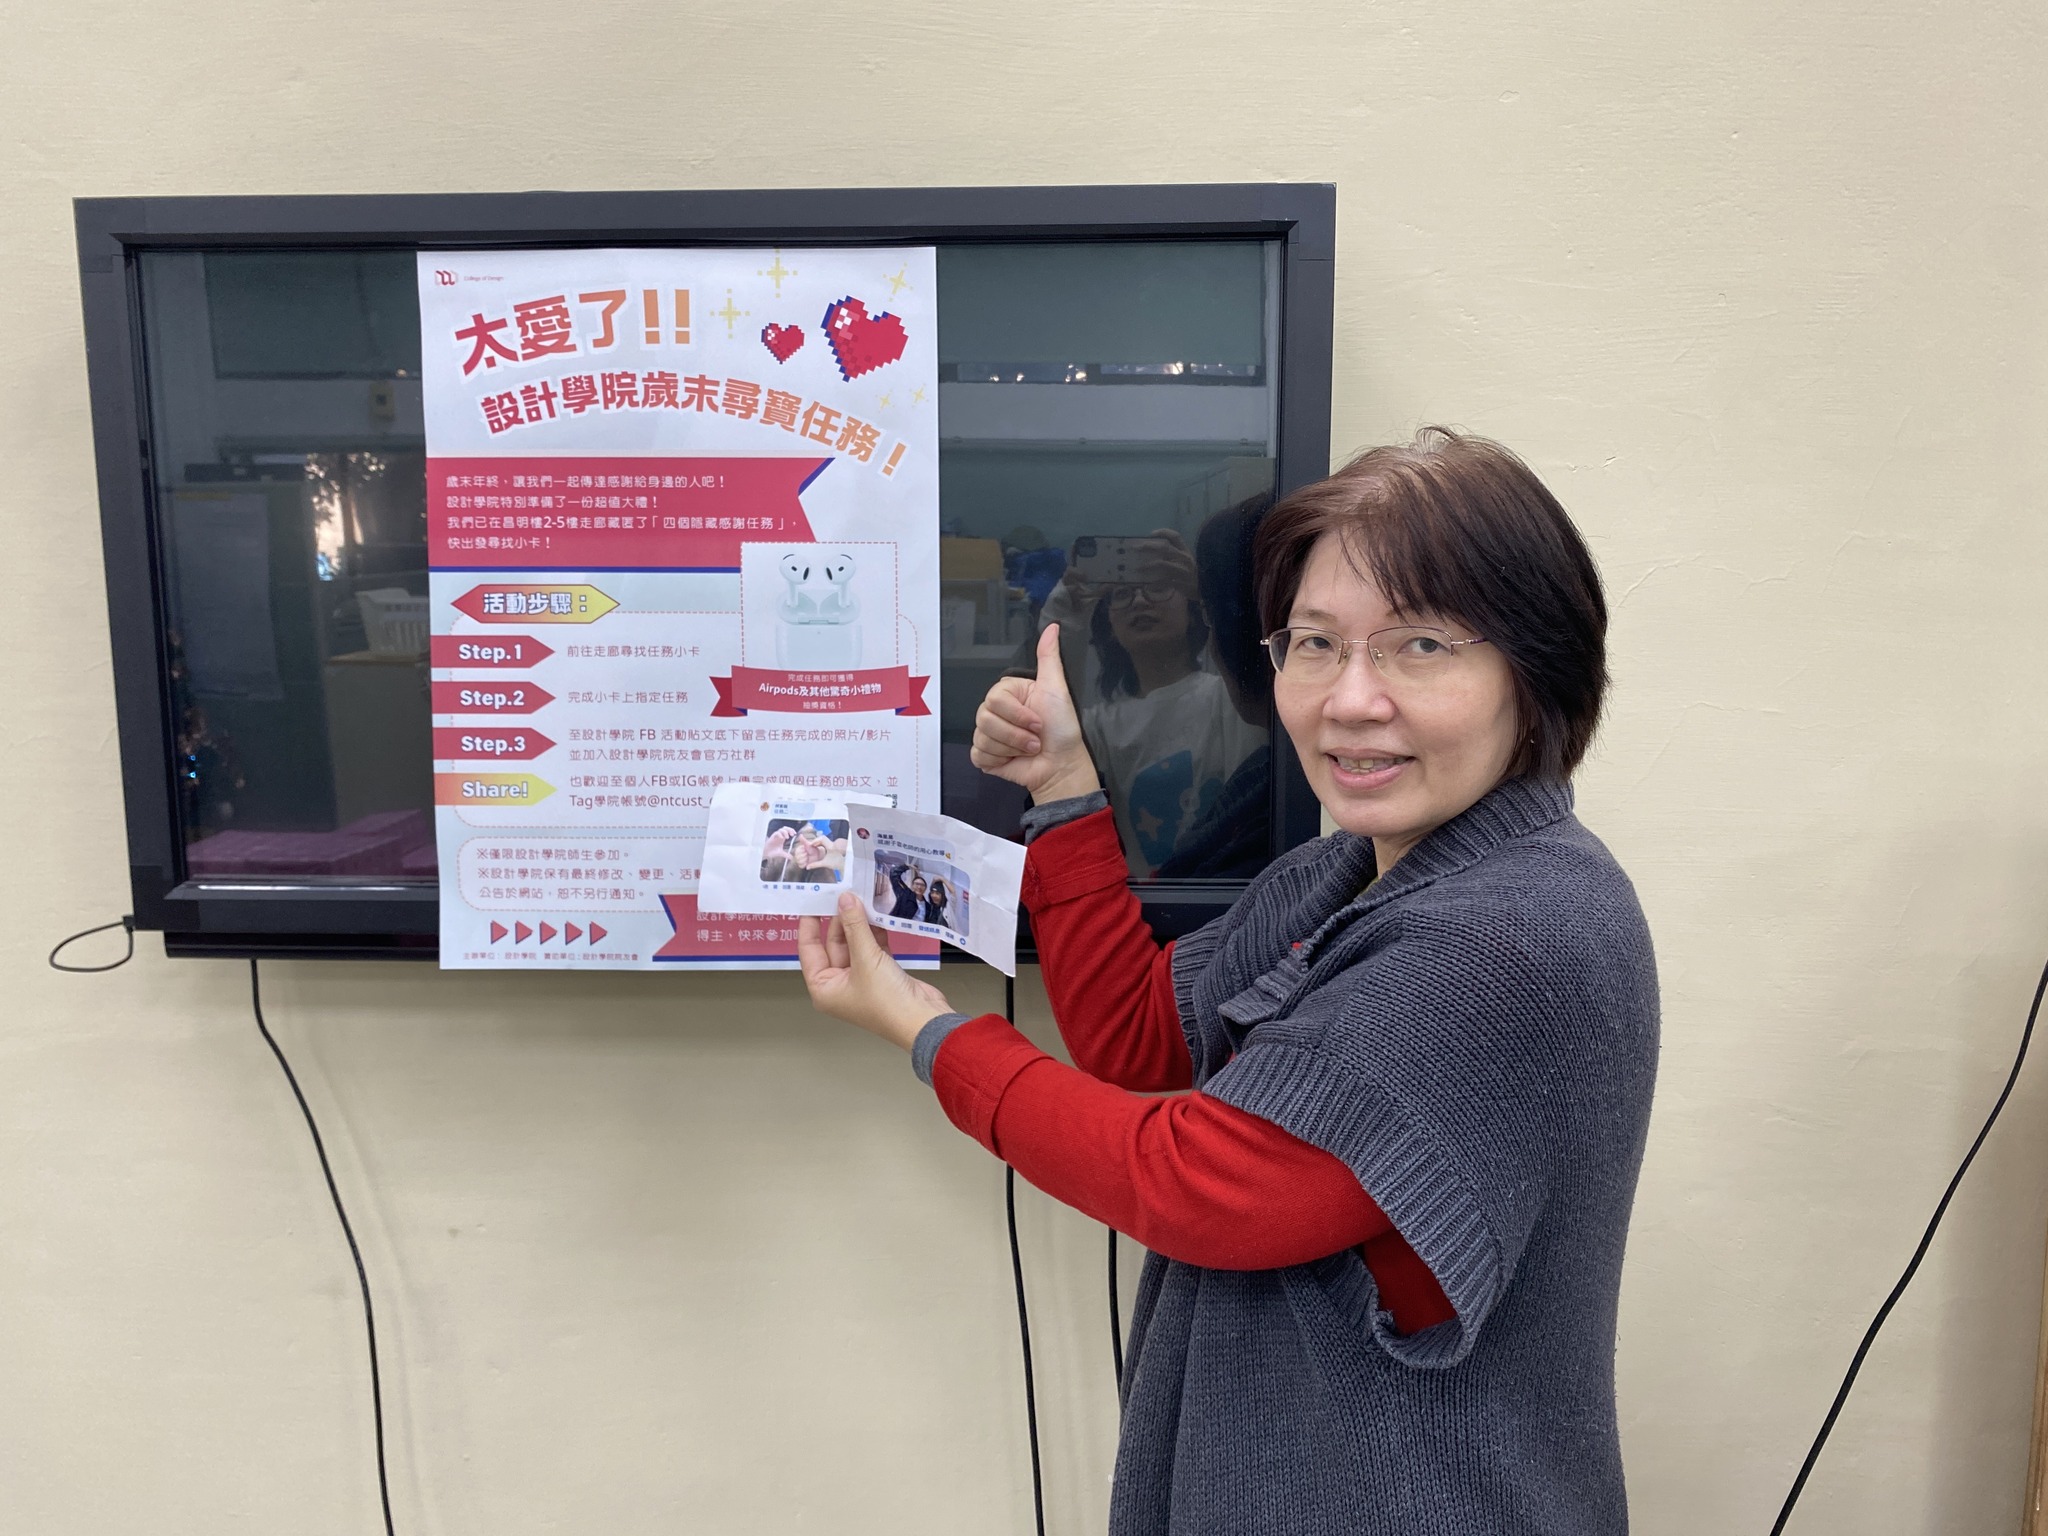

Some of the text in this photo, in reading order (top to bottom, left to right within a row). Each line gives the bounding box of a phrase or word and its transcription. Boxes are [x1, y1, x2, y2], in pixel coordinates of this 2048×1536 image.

[454, 288, 691, 377] 太愛了!!
[480, 371, 908, 476] 設計學院歲末尋寶任務！
[446, 495, 658, 509] 設計學院特別準備了一份超值大禮！
[447, 536, 551, 549] 快出發尋找小卡！
[483, 592, 587, 614] 活動步驟：
[458, 644, 522, 663] Step.1
[567, 645, 700, 658] 前往走廊尋找任務小卡
[460, 690, 525, 709] Step.2
[568, 691, 688, 704] 完成小卡上指定任務
[569, 729, 892, 741] 至設計學院 FB 活動貼文底下留言任務完成的照片/影片
[461, 736, 526, 755] Step.3
[569, 749, 756, 761] 並加入設計學院院友會官方社群
[462, 781, 529, 798] Share!
[569, 795, 712, 810] Tag學院帳號@ntcust_
